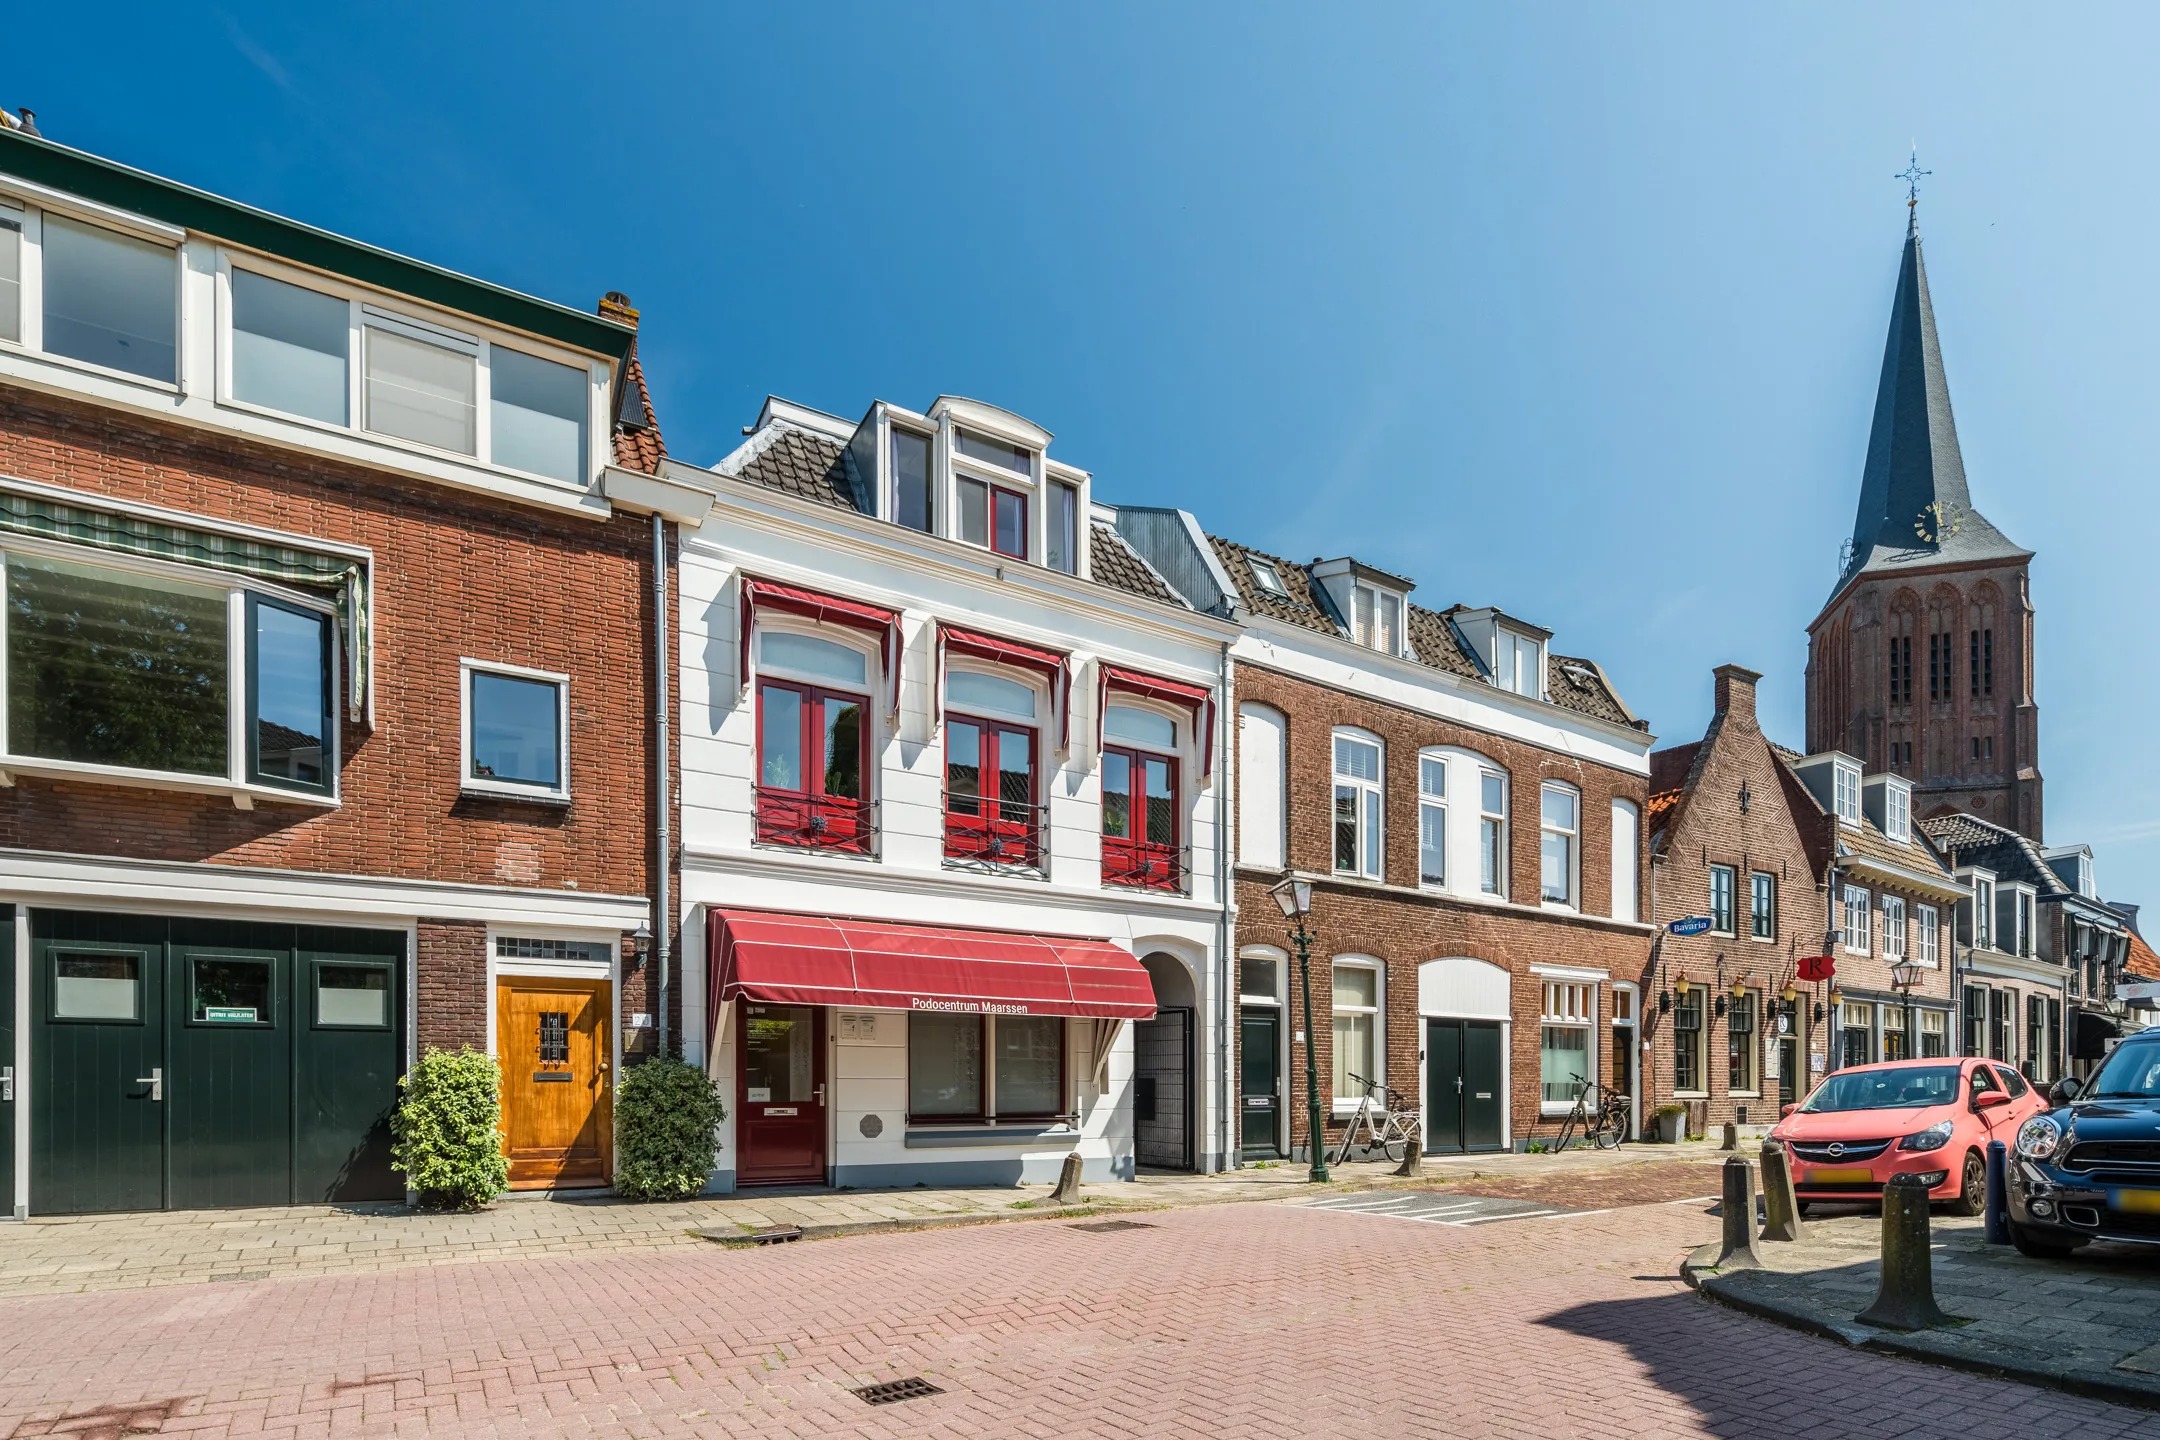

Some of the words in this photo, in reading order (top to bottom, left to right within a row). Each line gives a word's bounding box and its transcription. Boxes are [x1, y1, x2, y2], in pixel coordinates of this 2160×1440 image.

[1674, 921, 1707, 933] Bavaria
[1809, 958, 1824, 975] R
[912, 997, 979, 1012] Podocentrum
[981, 1001, 1028, 1014] Maarssen
